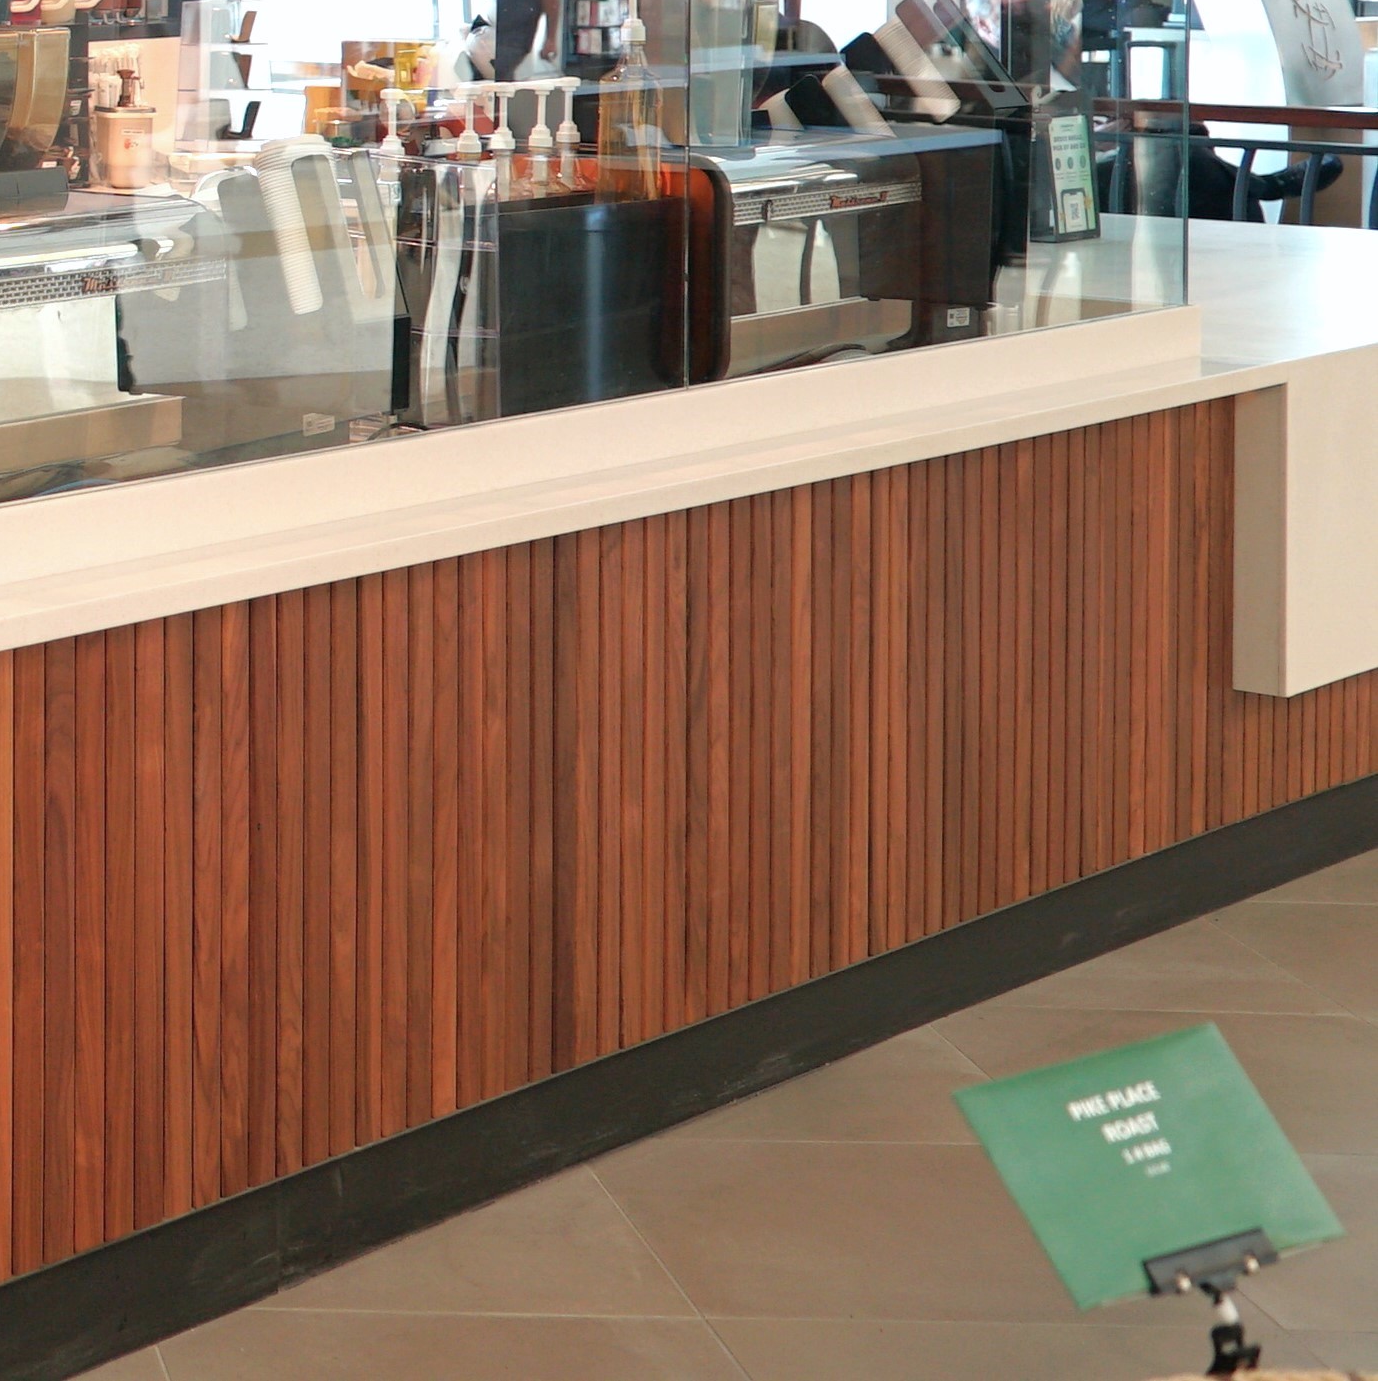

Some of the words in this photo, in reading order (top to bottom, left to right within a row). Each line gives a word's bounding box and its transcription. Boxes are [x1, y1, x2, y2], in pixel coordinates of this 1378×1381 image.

[1067, 1093, 1111, 1122] PIKE
[1105, 1079, 1162, 1110] PLACE
[1101, 1110, 1160, 1145] ROAST
